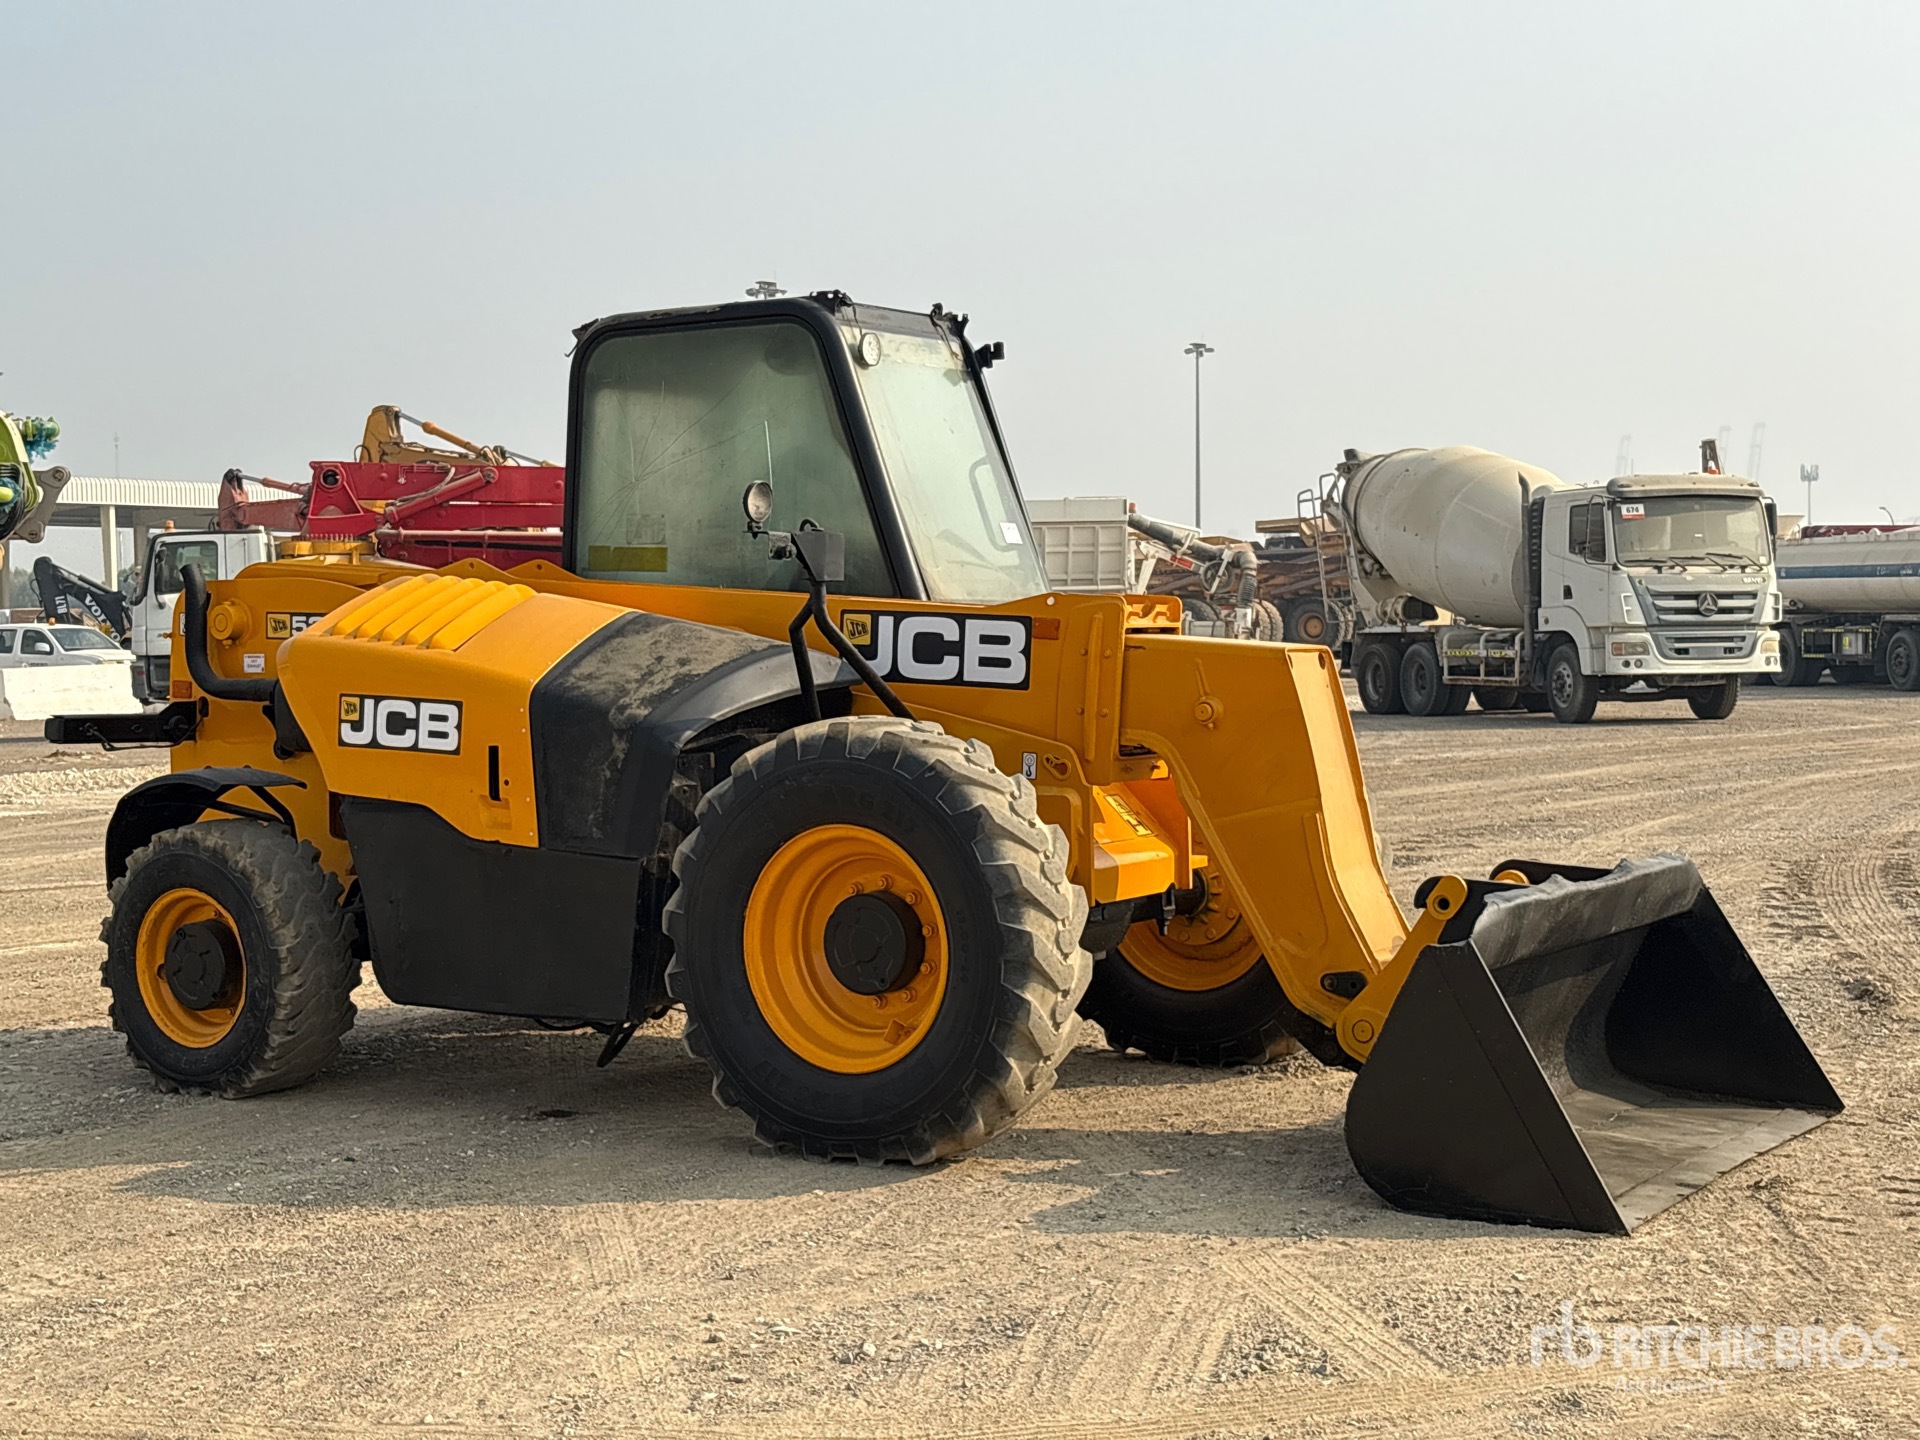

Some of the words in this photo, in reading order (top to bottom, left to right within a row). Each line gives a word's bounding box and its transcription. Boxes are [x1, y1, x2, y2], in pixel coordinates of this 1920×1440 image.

[1625, 506, 1640, 514] 674
[55, 595, 68, 614] BL71
[848, 620, 868, 637] JCB
[863, 616, 1026, 684] JCB
[341, 698, 459, 751] JCB
